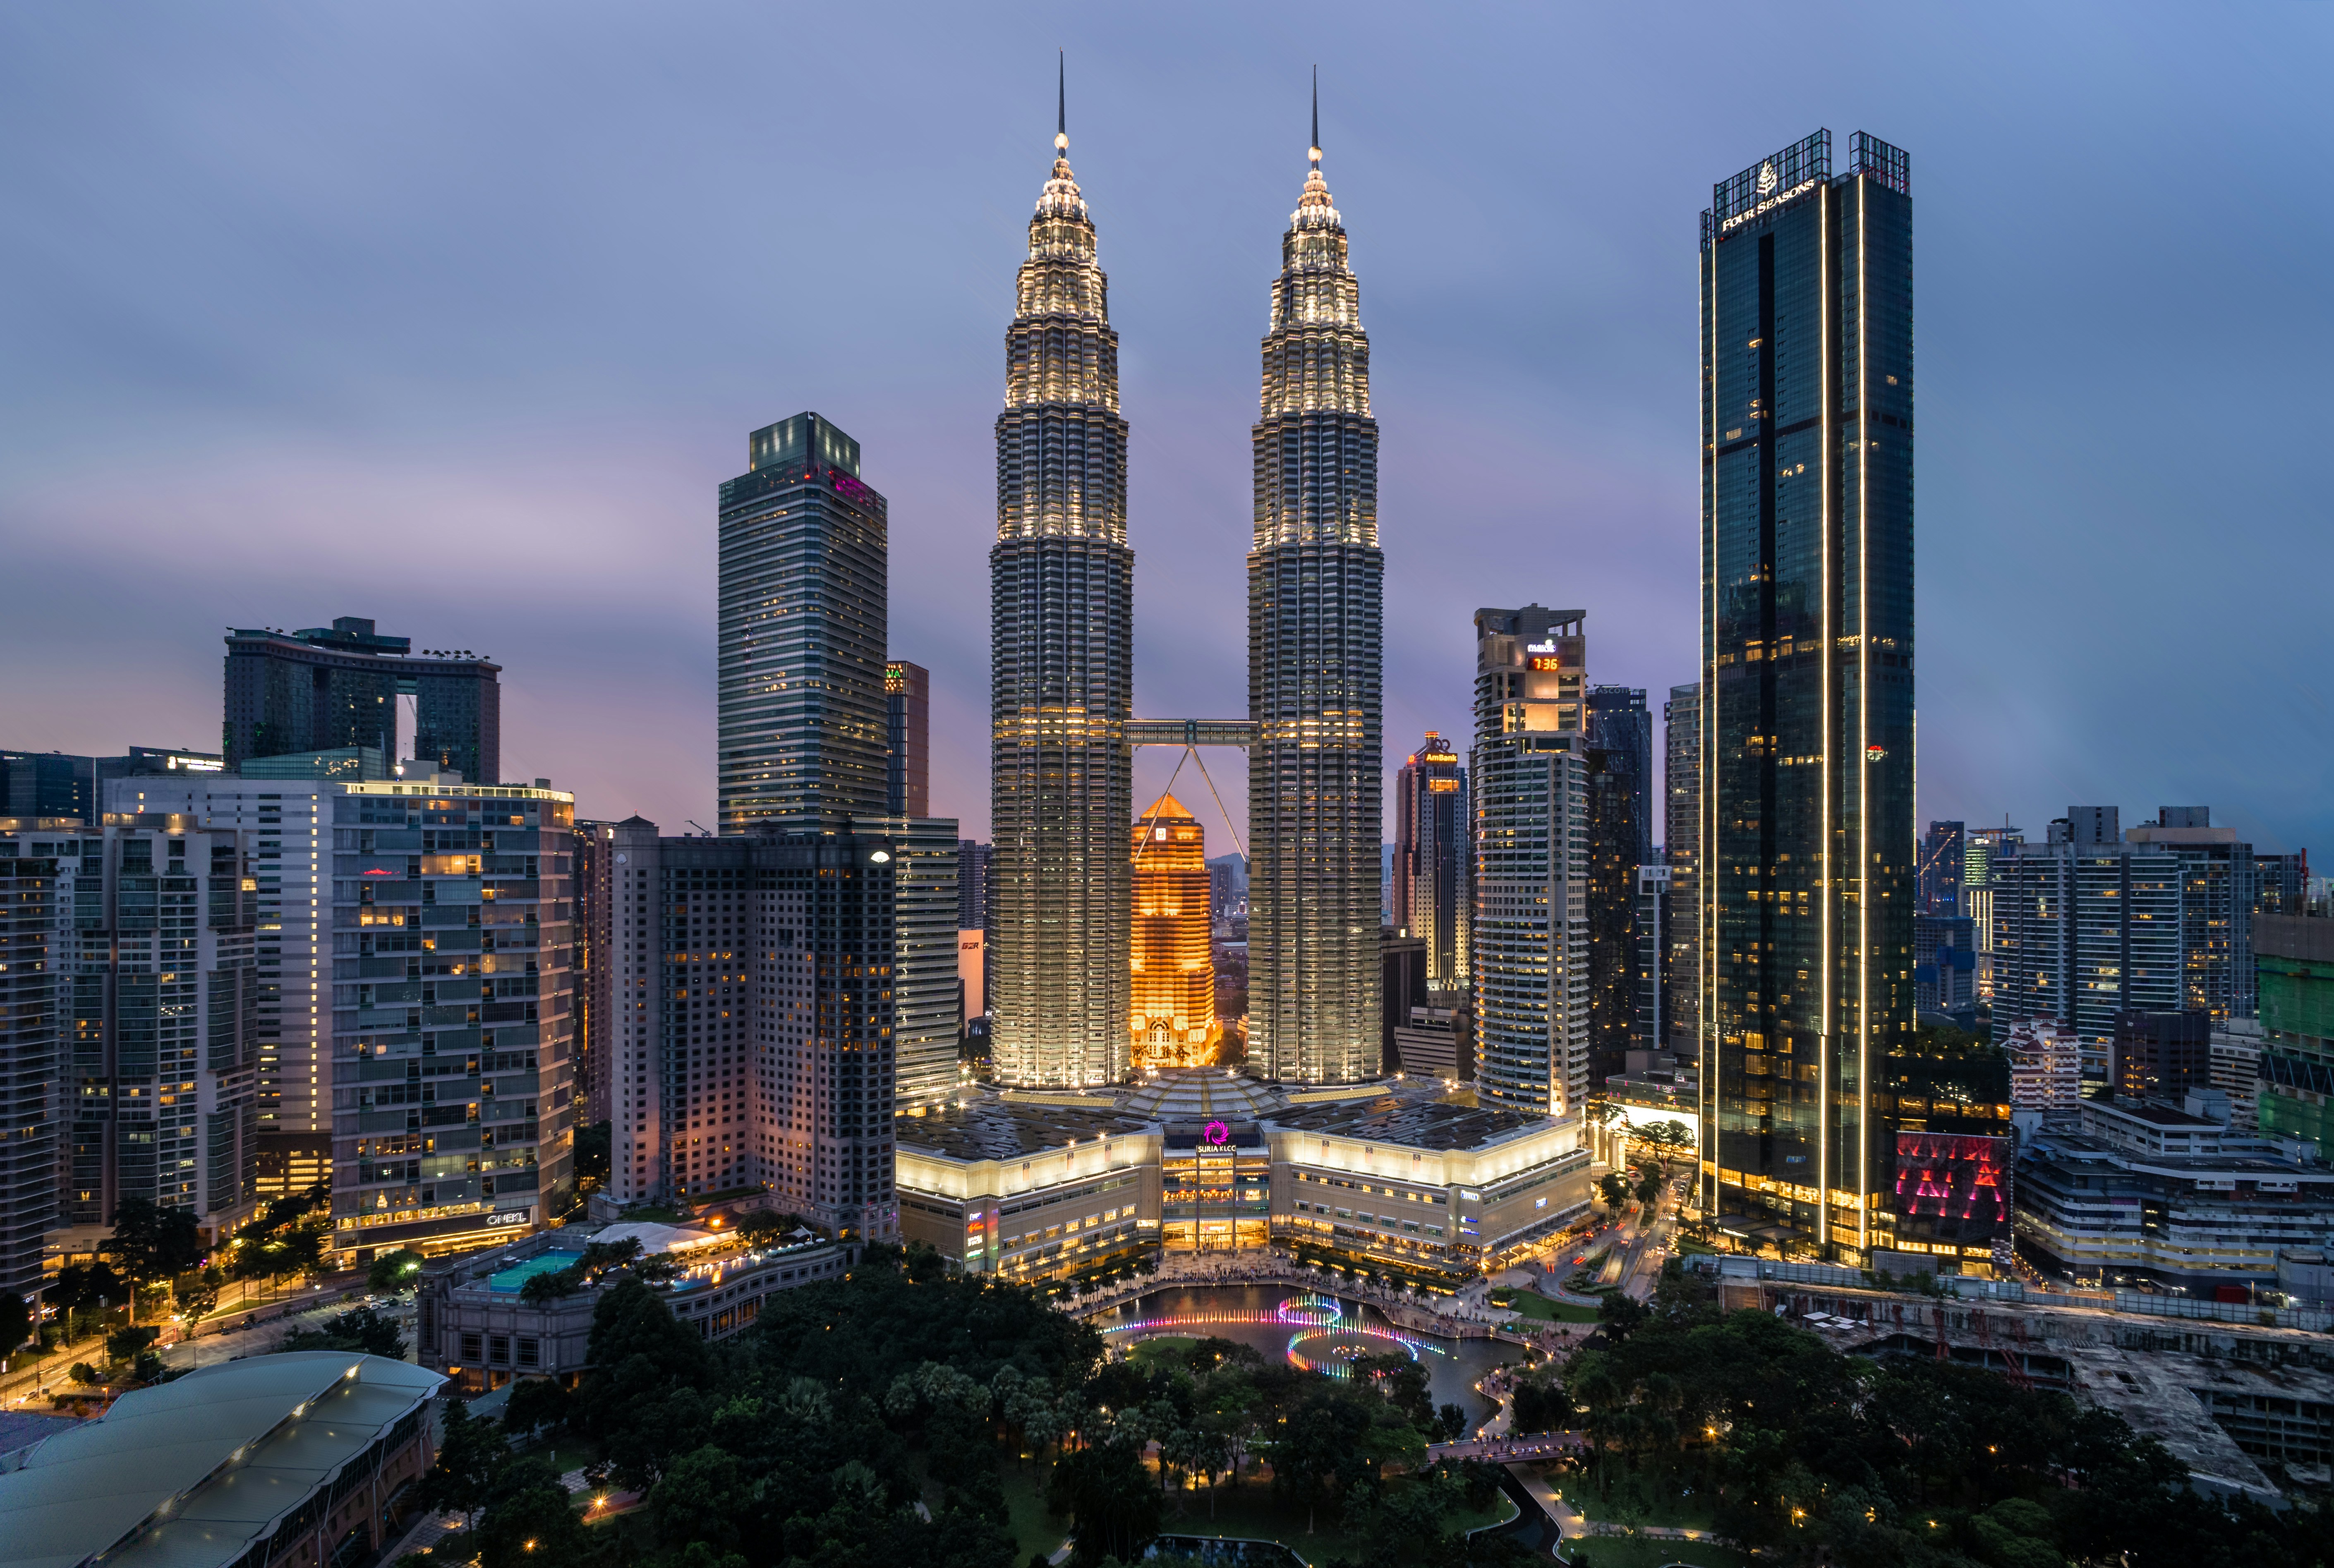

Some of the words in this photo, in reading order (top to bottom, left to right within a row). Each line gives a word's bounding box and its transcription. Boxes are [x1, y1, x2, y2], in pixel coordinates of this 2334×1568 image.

[1722, 209, 1755, 232] FOUR
[1757, 179, 1815, 215] SEASONS
[1534, 658, 1558, 670] 7:36
[1426, 753, 1457, 762] AmBank
